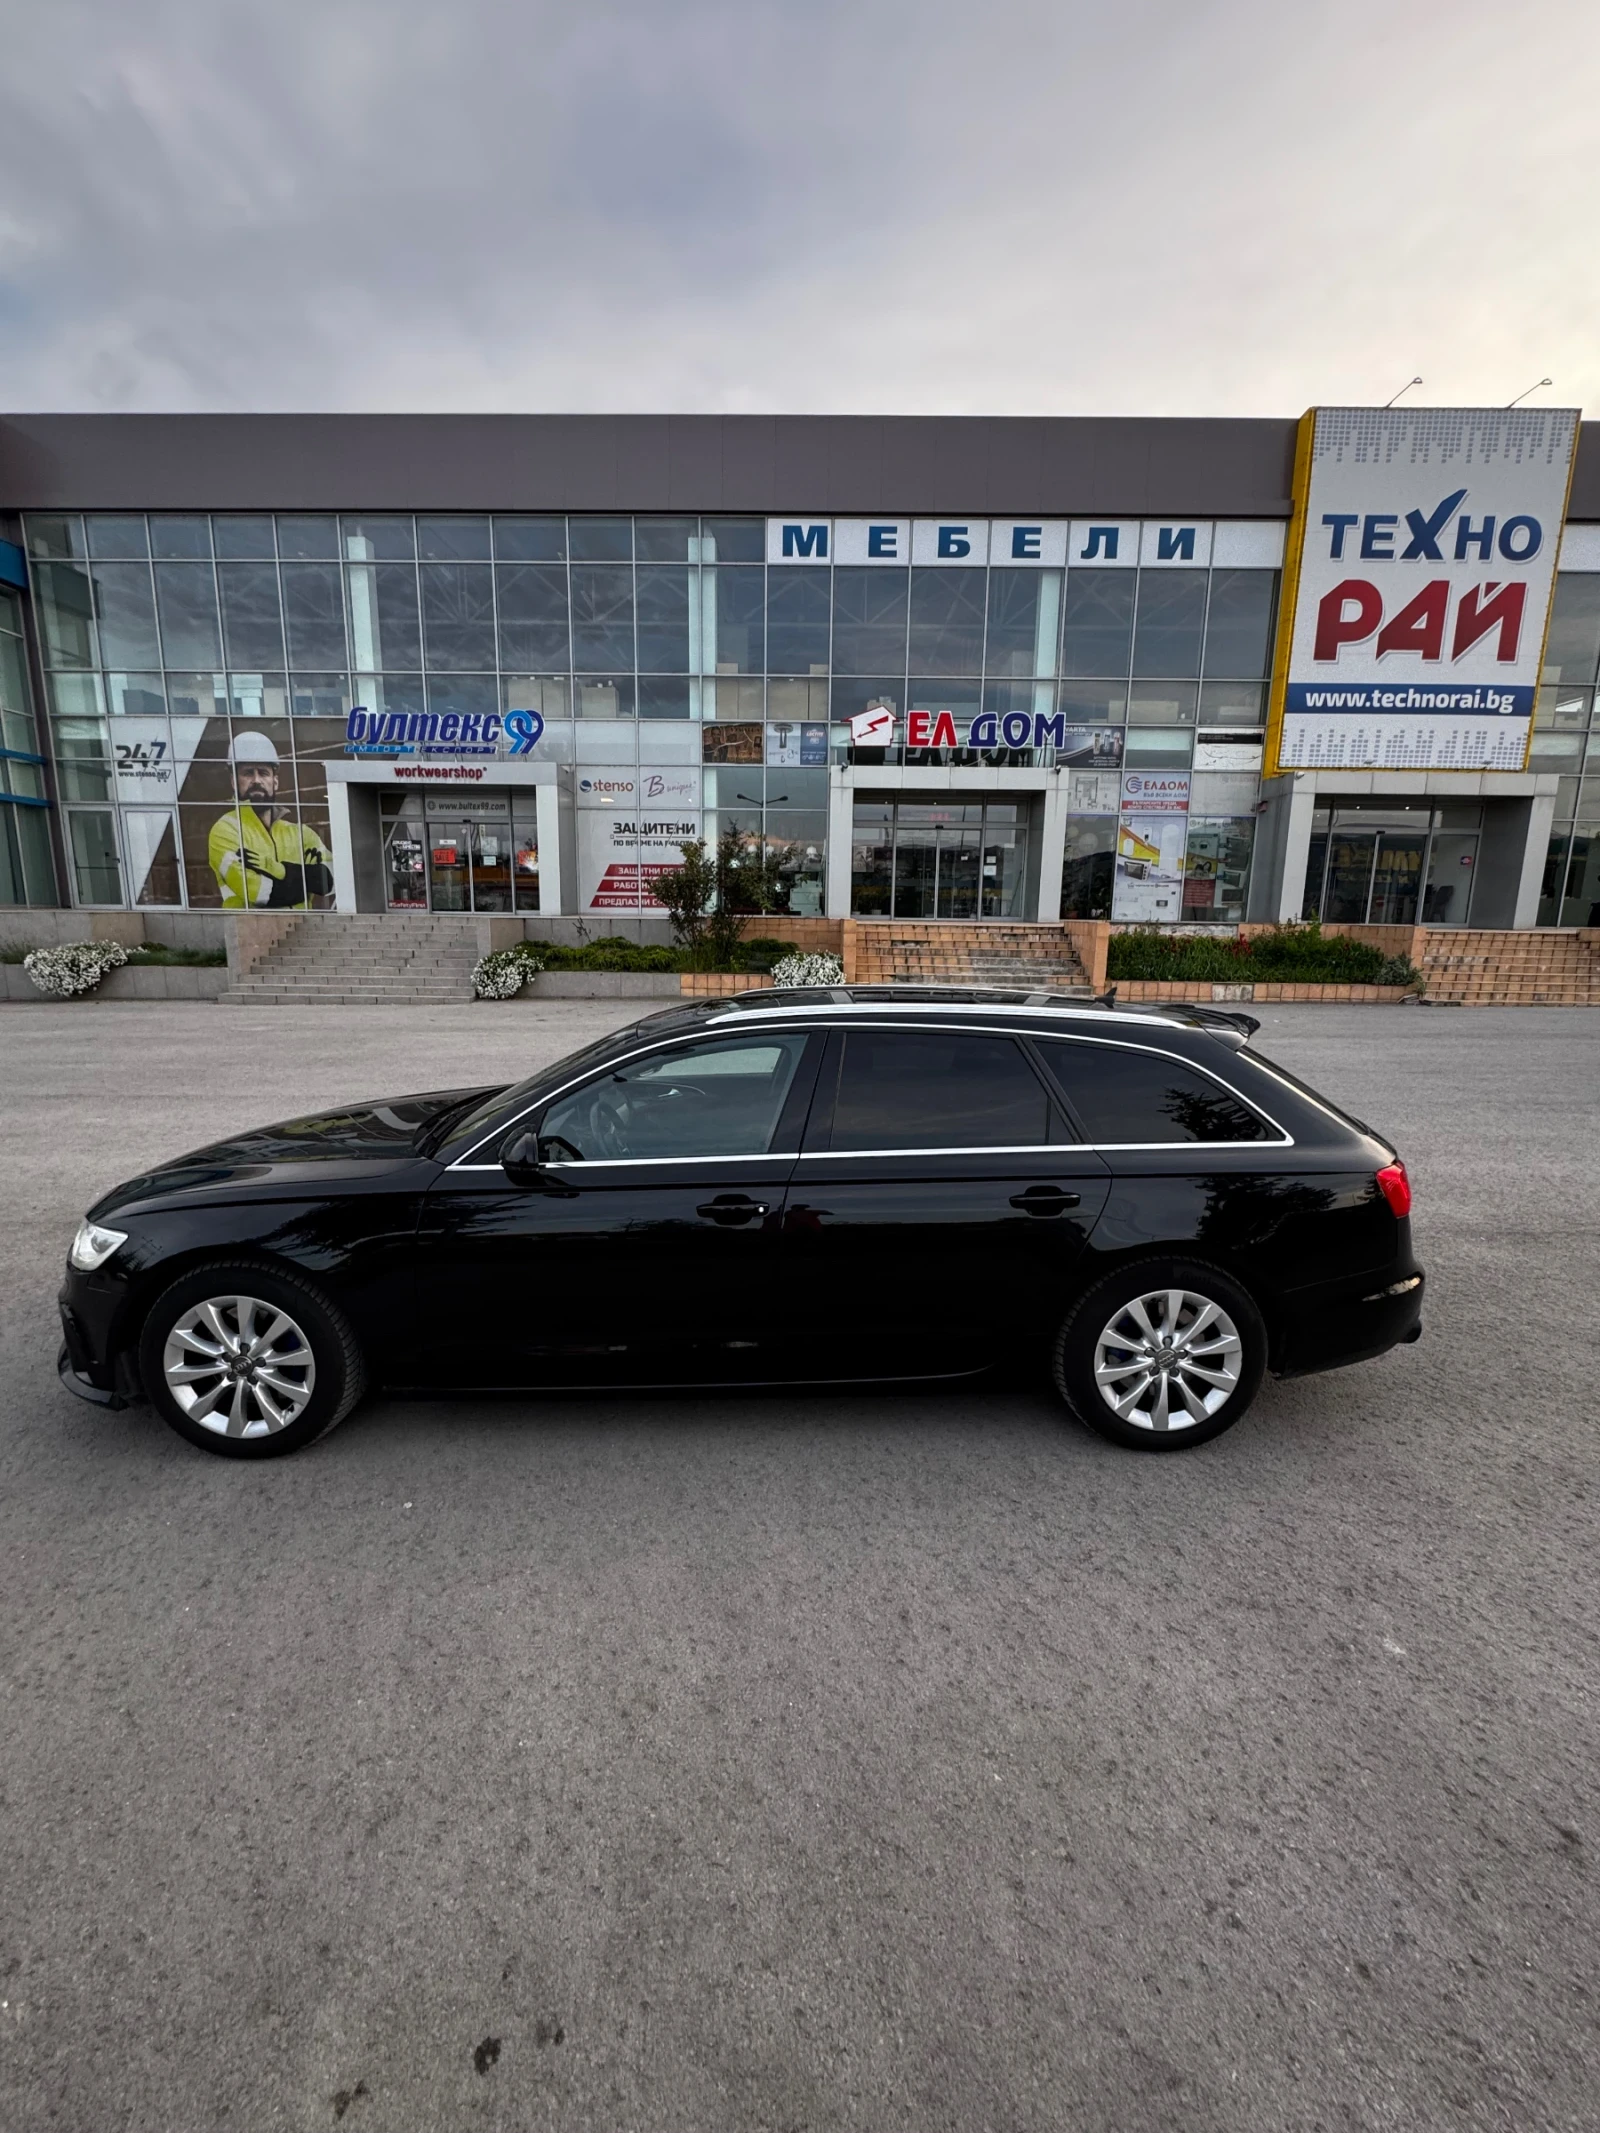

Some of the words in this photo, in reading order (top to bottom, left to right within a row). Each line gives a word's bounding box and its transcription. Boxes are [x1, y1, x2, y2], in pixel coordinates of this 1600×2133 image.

[1322, 489, 1543, 561] ТЕХНО
[782, 525, 1197, 560] МЕБЕЛИ
[1313, 579, 1527, 662] РАЙ
[1305, 688, 1516, 713] www.technorai.bg
[347, 706, 501, 745] бултекс
[593, 779, 634, 792] stenso
[1143, 780, 1188, 791] ЕЛДОМ
[438, 802, 506, 811] www.bultex99.com
